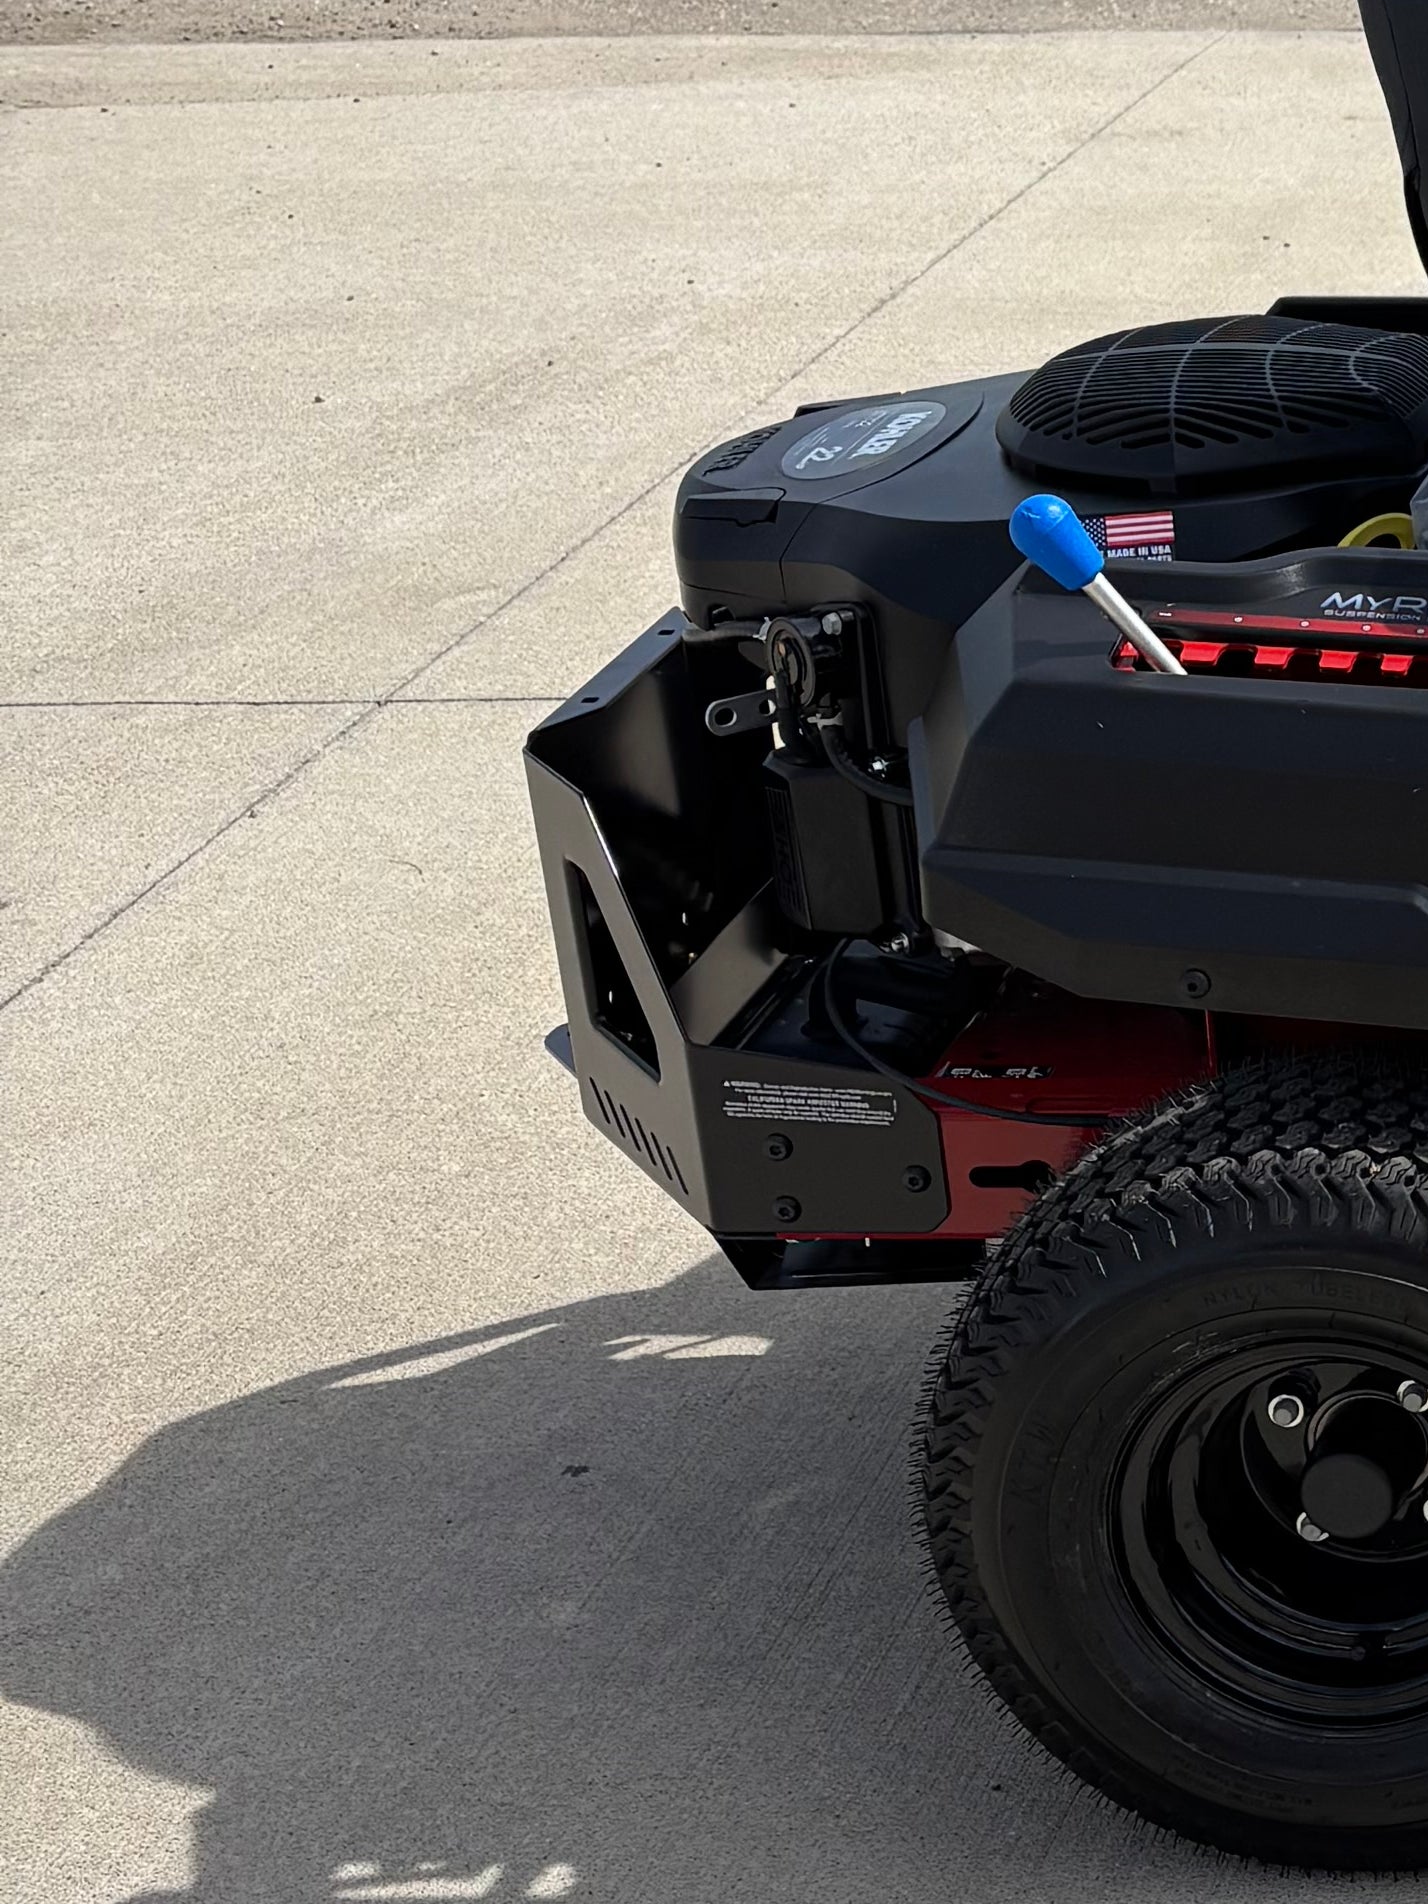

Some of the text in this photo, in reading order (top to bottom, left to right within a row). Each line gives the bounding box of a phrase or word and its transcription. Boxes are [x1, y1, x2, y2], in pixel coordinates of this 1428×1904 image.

[1107, 548, 1136, 558] MADE
[1138, 547, 1149, 556] IN
[1151, 544, 1172, 554] USA
[1323, 608, 1421, 621] SUSPENSION
